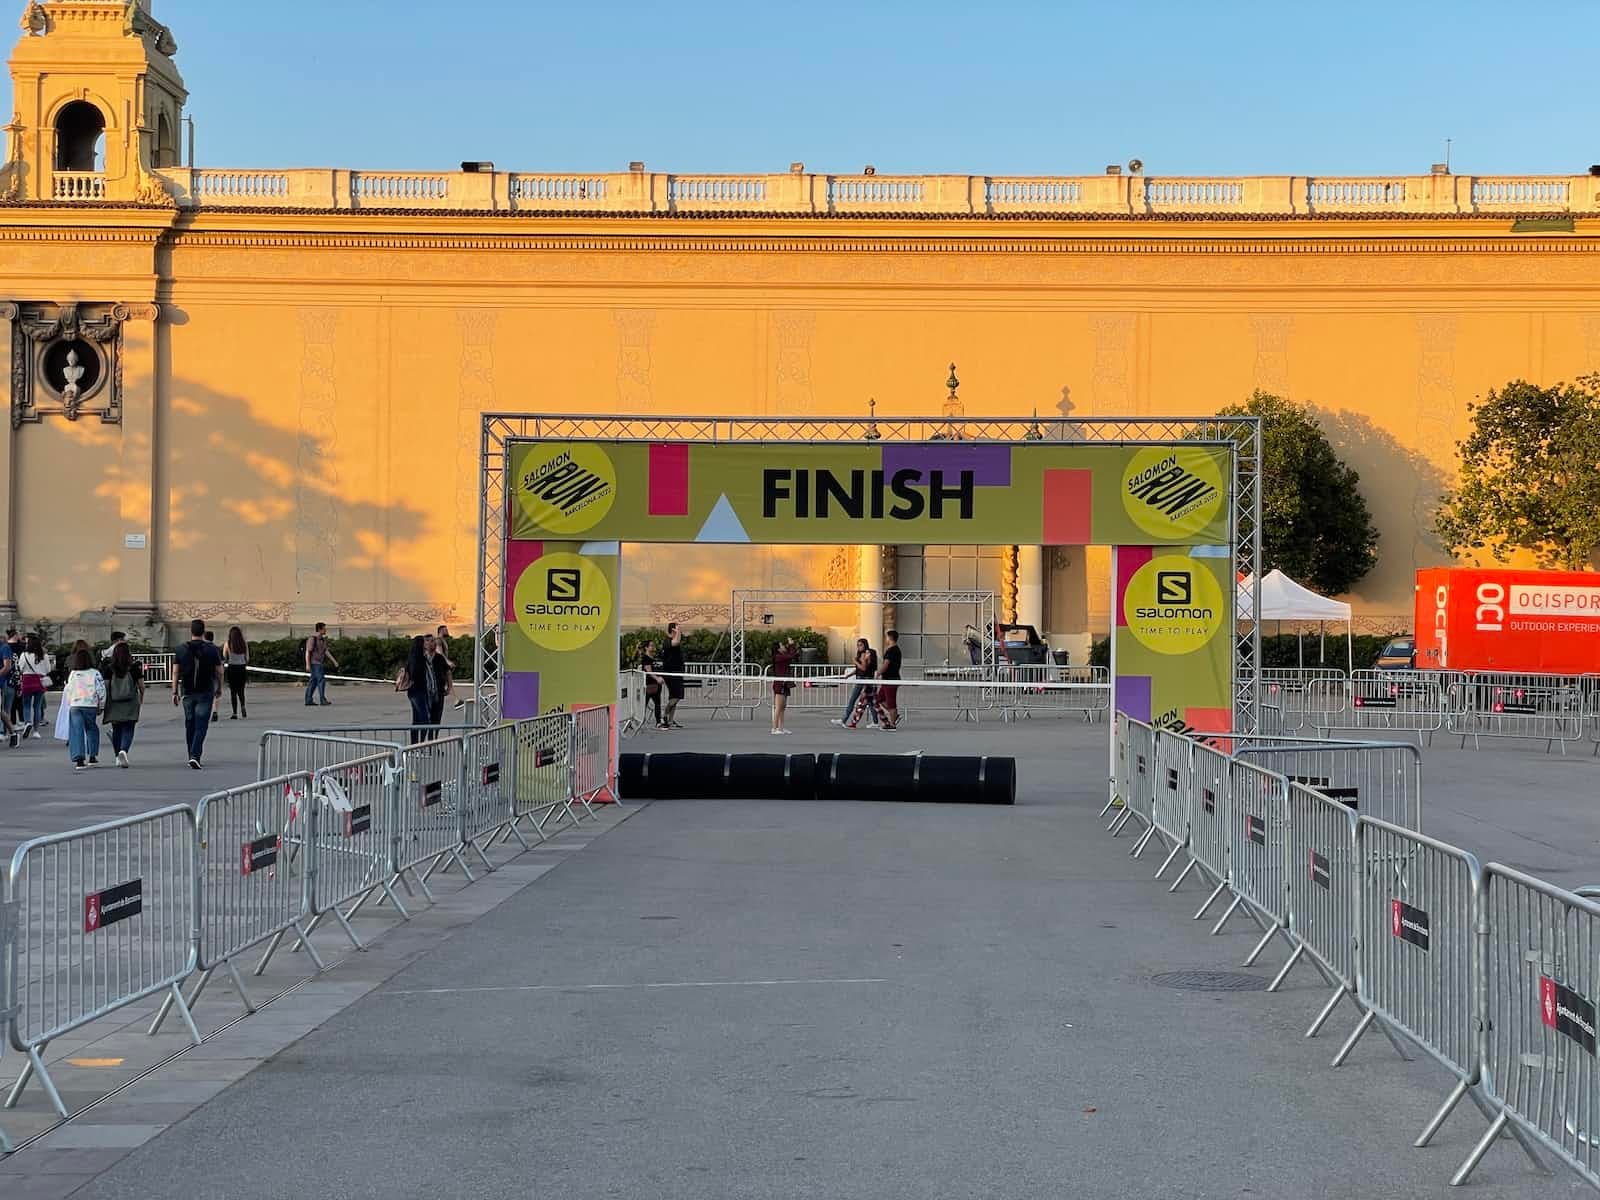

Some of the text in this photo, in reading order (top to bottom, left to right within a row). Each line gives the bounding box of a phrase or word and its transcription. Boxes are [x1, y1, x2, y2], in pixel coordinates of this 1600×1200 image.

[523, 449, 571, 486] SALOMON
[1128, 455, 1176, 490] SALOMON
[526, 462, 609, 511] RUN
[763, 469, 974, 520] FINISH
[1130, 466, 1215, 515] RUN
[565, 496, 597, 517] BARCELONA
[1170, 500, 1203, 521] BARCELONA
[1476, 583, 1504, 631] OCI
[1519, 593, 1600, 609] OCISPOR
[530, 623, 597, 632] TIME TO PLAY
[1140, 627, 1208, 635] TIME TO PLAY
[1510, 621, 1556, 632] OUTDOOR
